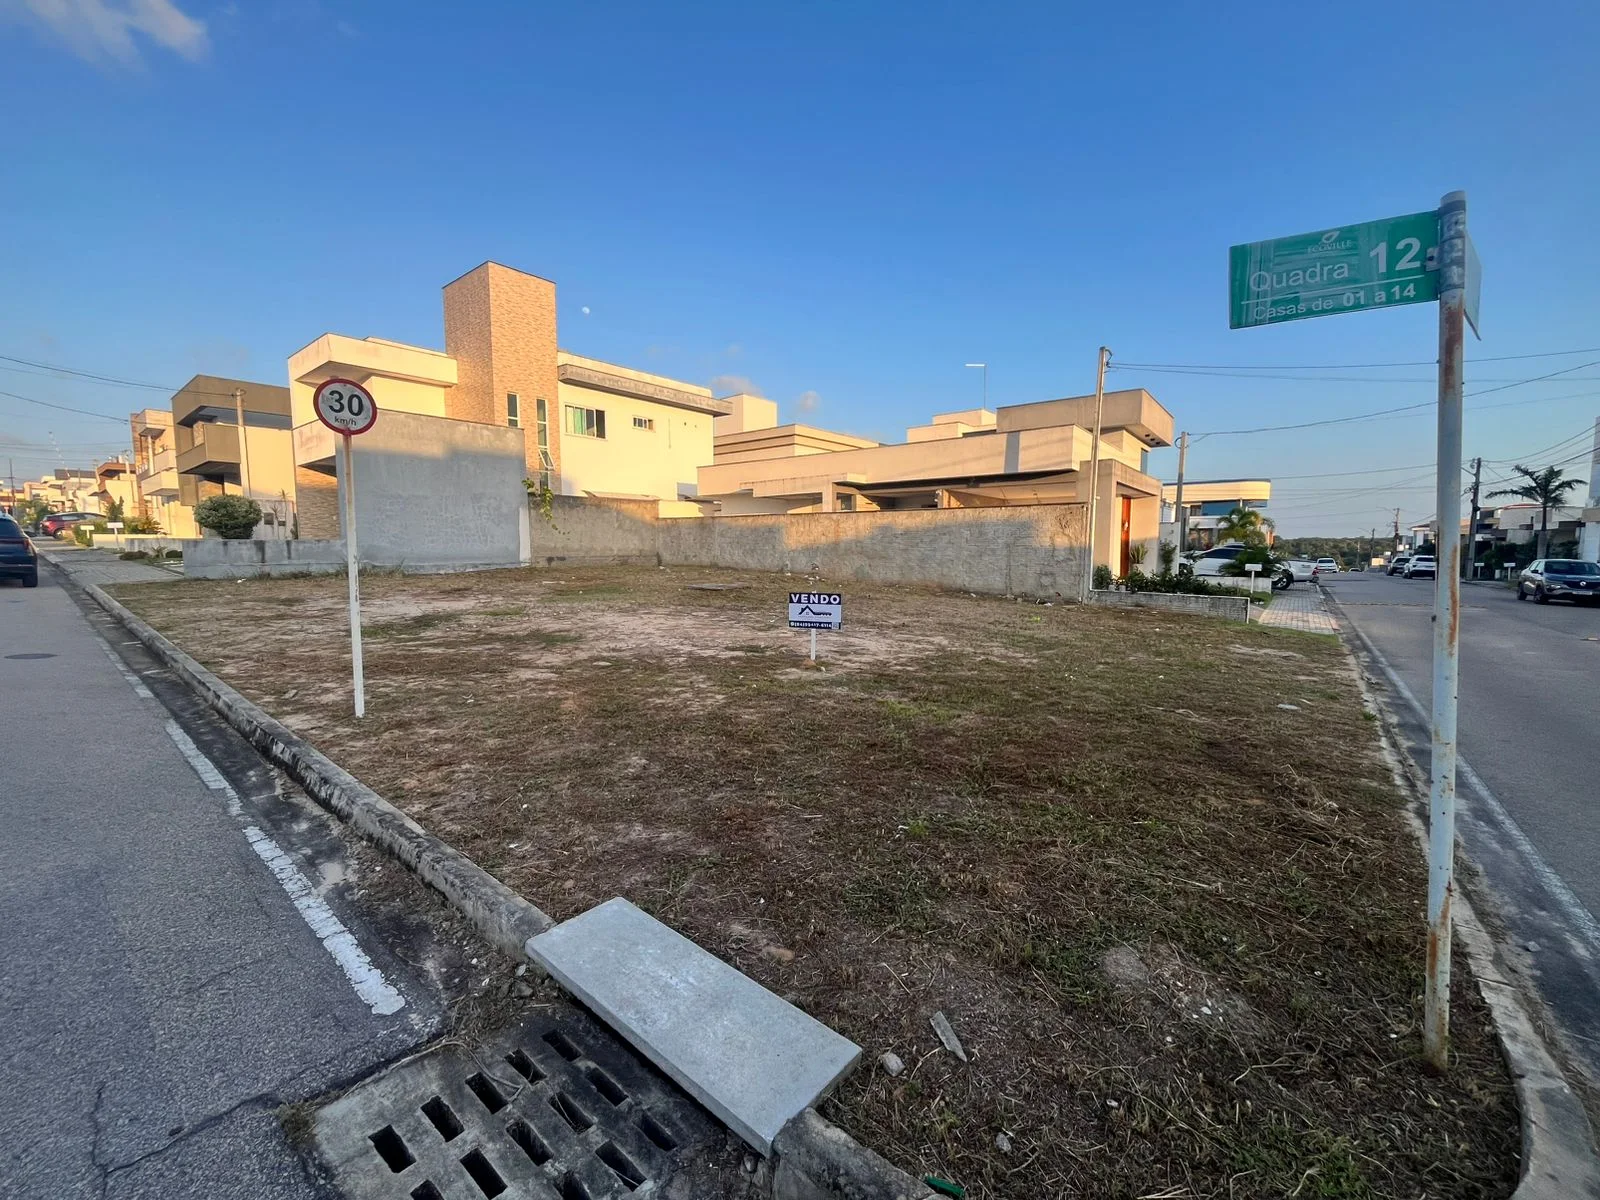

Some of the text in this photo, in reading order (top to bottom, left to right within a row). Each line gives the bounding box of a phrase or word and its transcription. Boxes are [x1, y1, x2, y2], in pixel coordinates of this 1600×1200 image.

[1249, 237, 1421, 292] Quadra 12
[1253, 282, 1416, 320] Casas de 01 a 14
[328, 390, 364, 417] 30
[334, 416, 357, 426] km/h
[790, 593, 840, 604] VENDO
